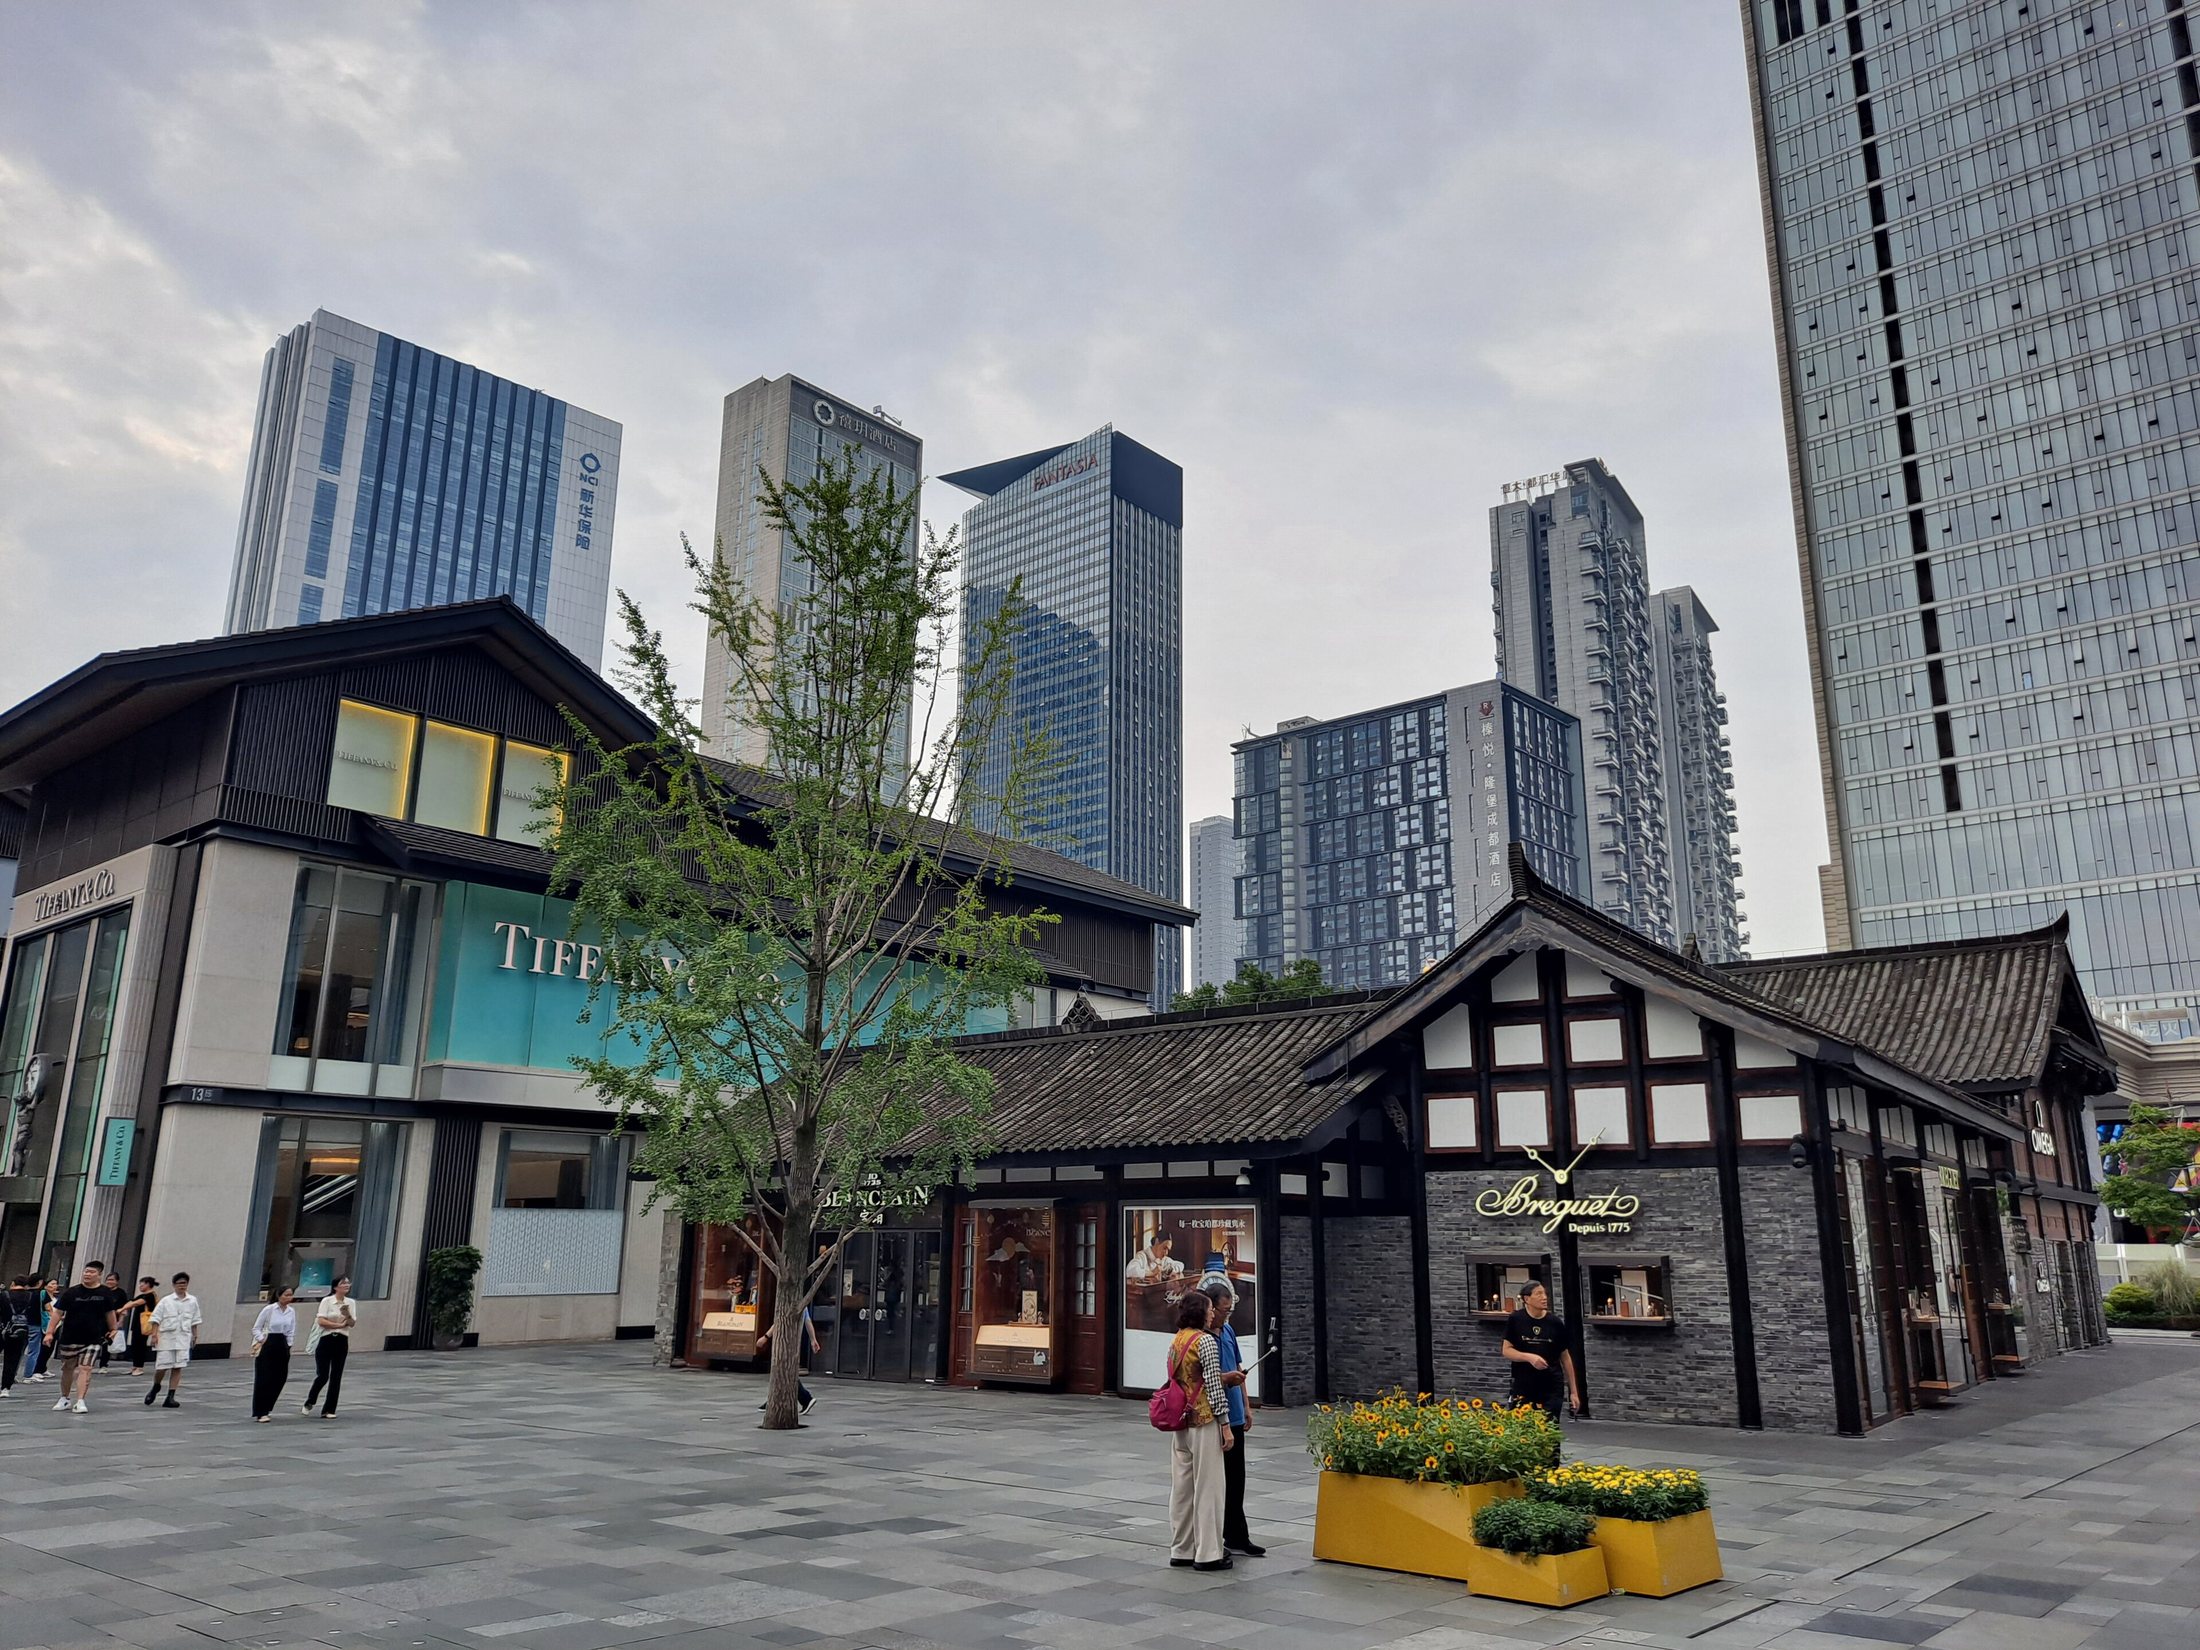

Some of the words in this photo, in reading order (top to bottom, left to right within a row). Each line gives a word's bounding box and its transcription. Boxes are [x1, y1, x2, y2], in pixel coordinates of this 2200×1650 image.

[580, 473, 598, 486] NCI
[1034, 454, 1098, 492] FANTASIA
[576, 488, 594, 550] 新华保险
[2032, 1129, 2055, 1156] OMEGA
[1475, 1174, 1639, 1234] Breguet
[1568, 1222, 1605, 1235] Depuis
[1607, 1222, 1631, 1233] 1775
